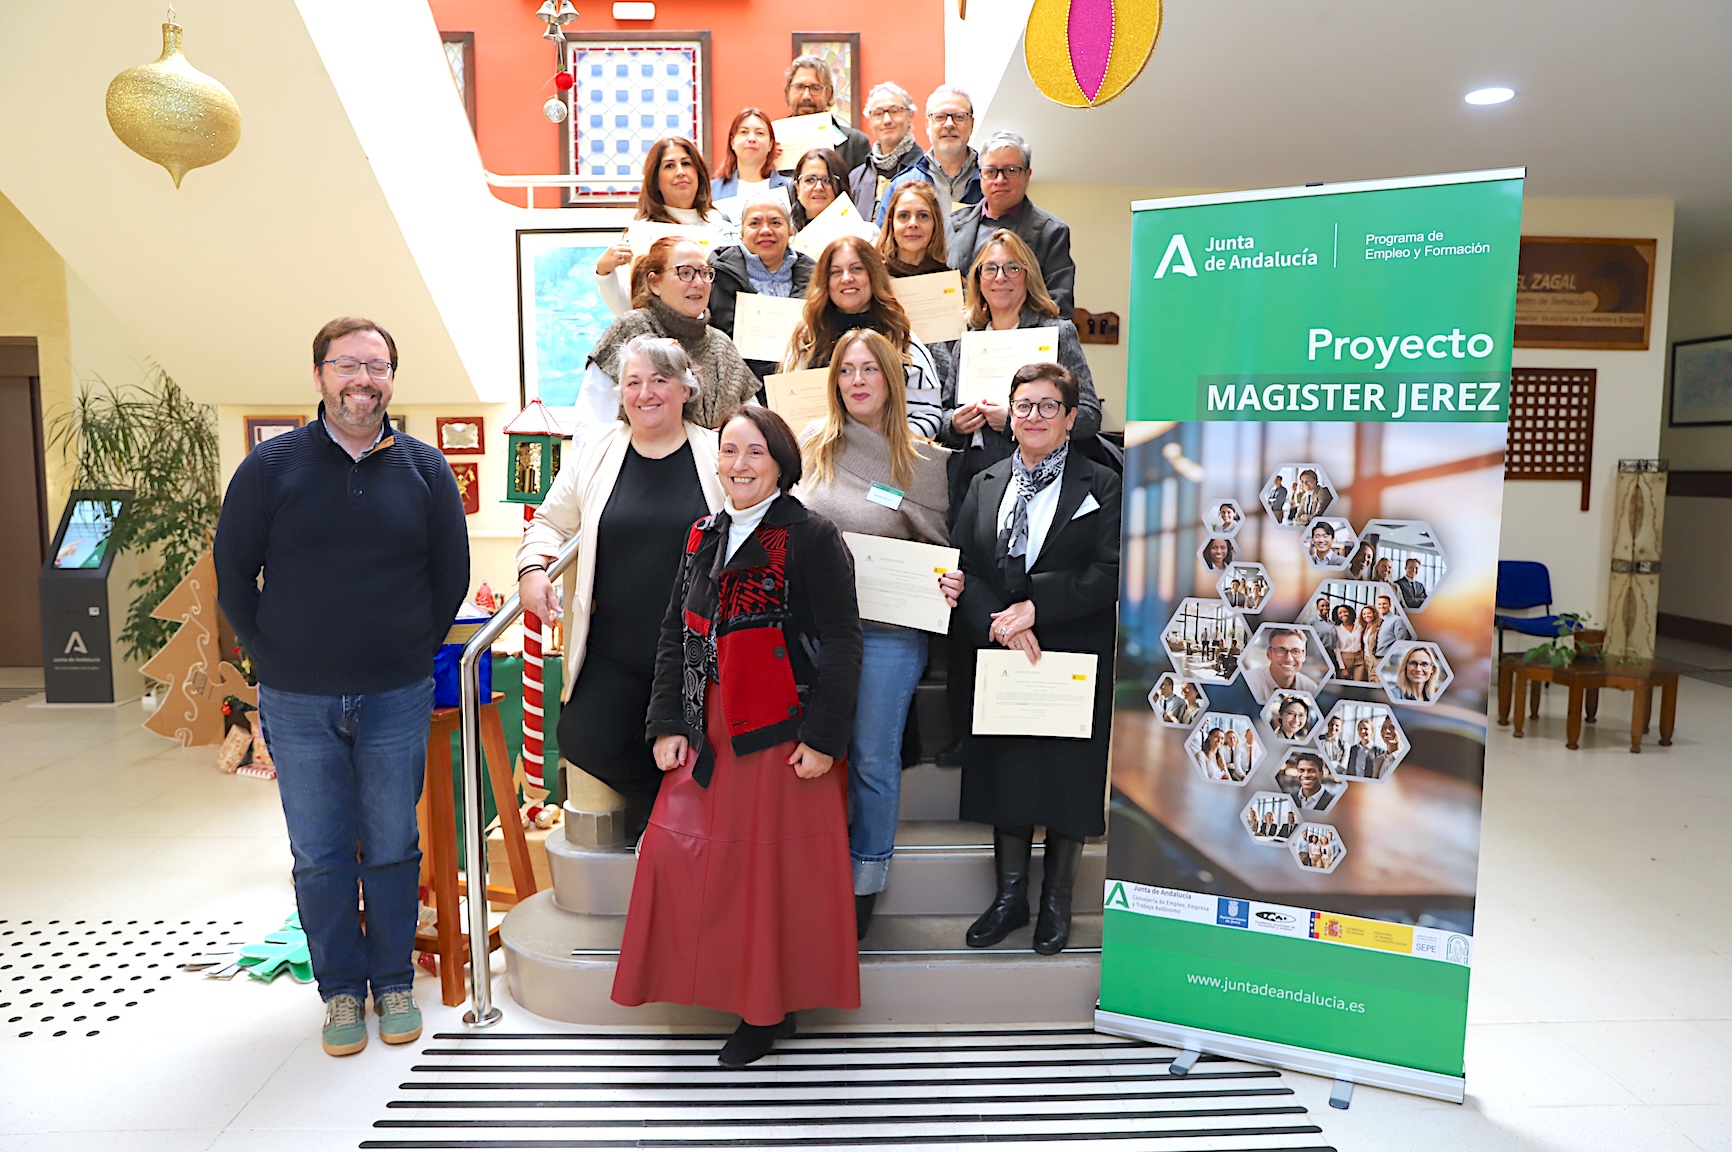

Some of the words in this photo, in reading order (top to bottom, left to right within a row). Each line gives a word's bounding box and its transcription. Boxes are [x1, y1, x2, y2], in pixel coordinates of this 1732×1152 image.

[1205, 236, 1254, 252] Junta
[1366, 234, 1424, 246] Programa
[1428, 230, 1444, 241] de
[1204, 256, 1225, 271] de
[1229, 248, 1317, 269] Andalucía
[1366, 248, 1410, 260] Empleo
[1414, 249, 1421, 259] y
[1425, 243, 1490, 256] Formación
[1531, 274, 1576, 290] ZAGAL
[1308, 329, 1494, 369] Proyecto
[1207, 384, 1385, 411] MAGISTER
[1392, 382, 1501, 418] JEREZ
[1134, 885, 1150, 893] Junta
[1161, 890, 1192, 899] Andalucía
[1133, 895, 1157, 904] Consejería
[1166, 900, 1186, 908] Empleo,
[1188, 903, 1209, 911] Empresa
[1155, 905, 1181, 913] Autónomo
[1416, 943, 1437, 953] SEPE
[1187, 973, 1365, 1013] www.juntadeandalucia.es
